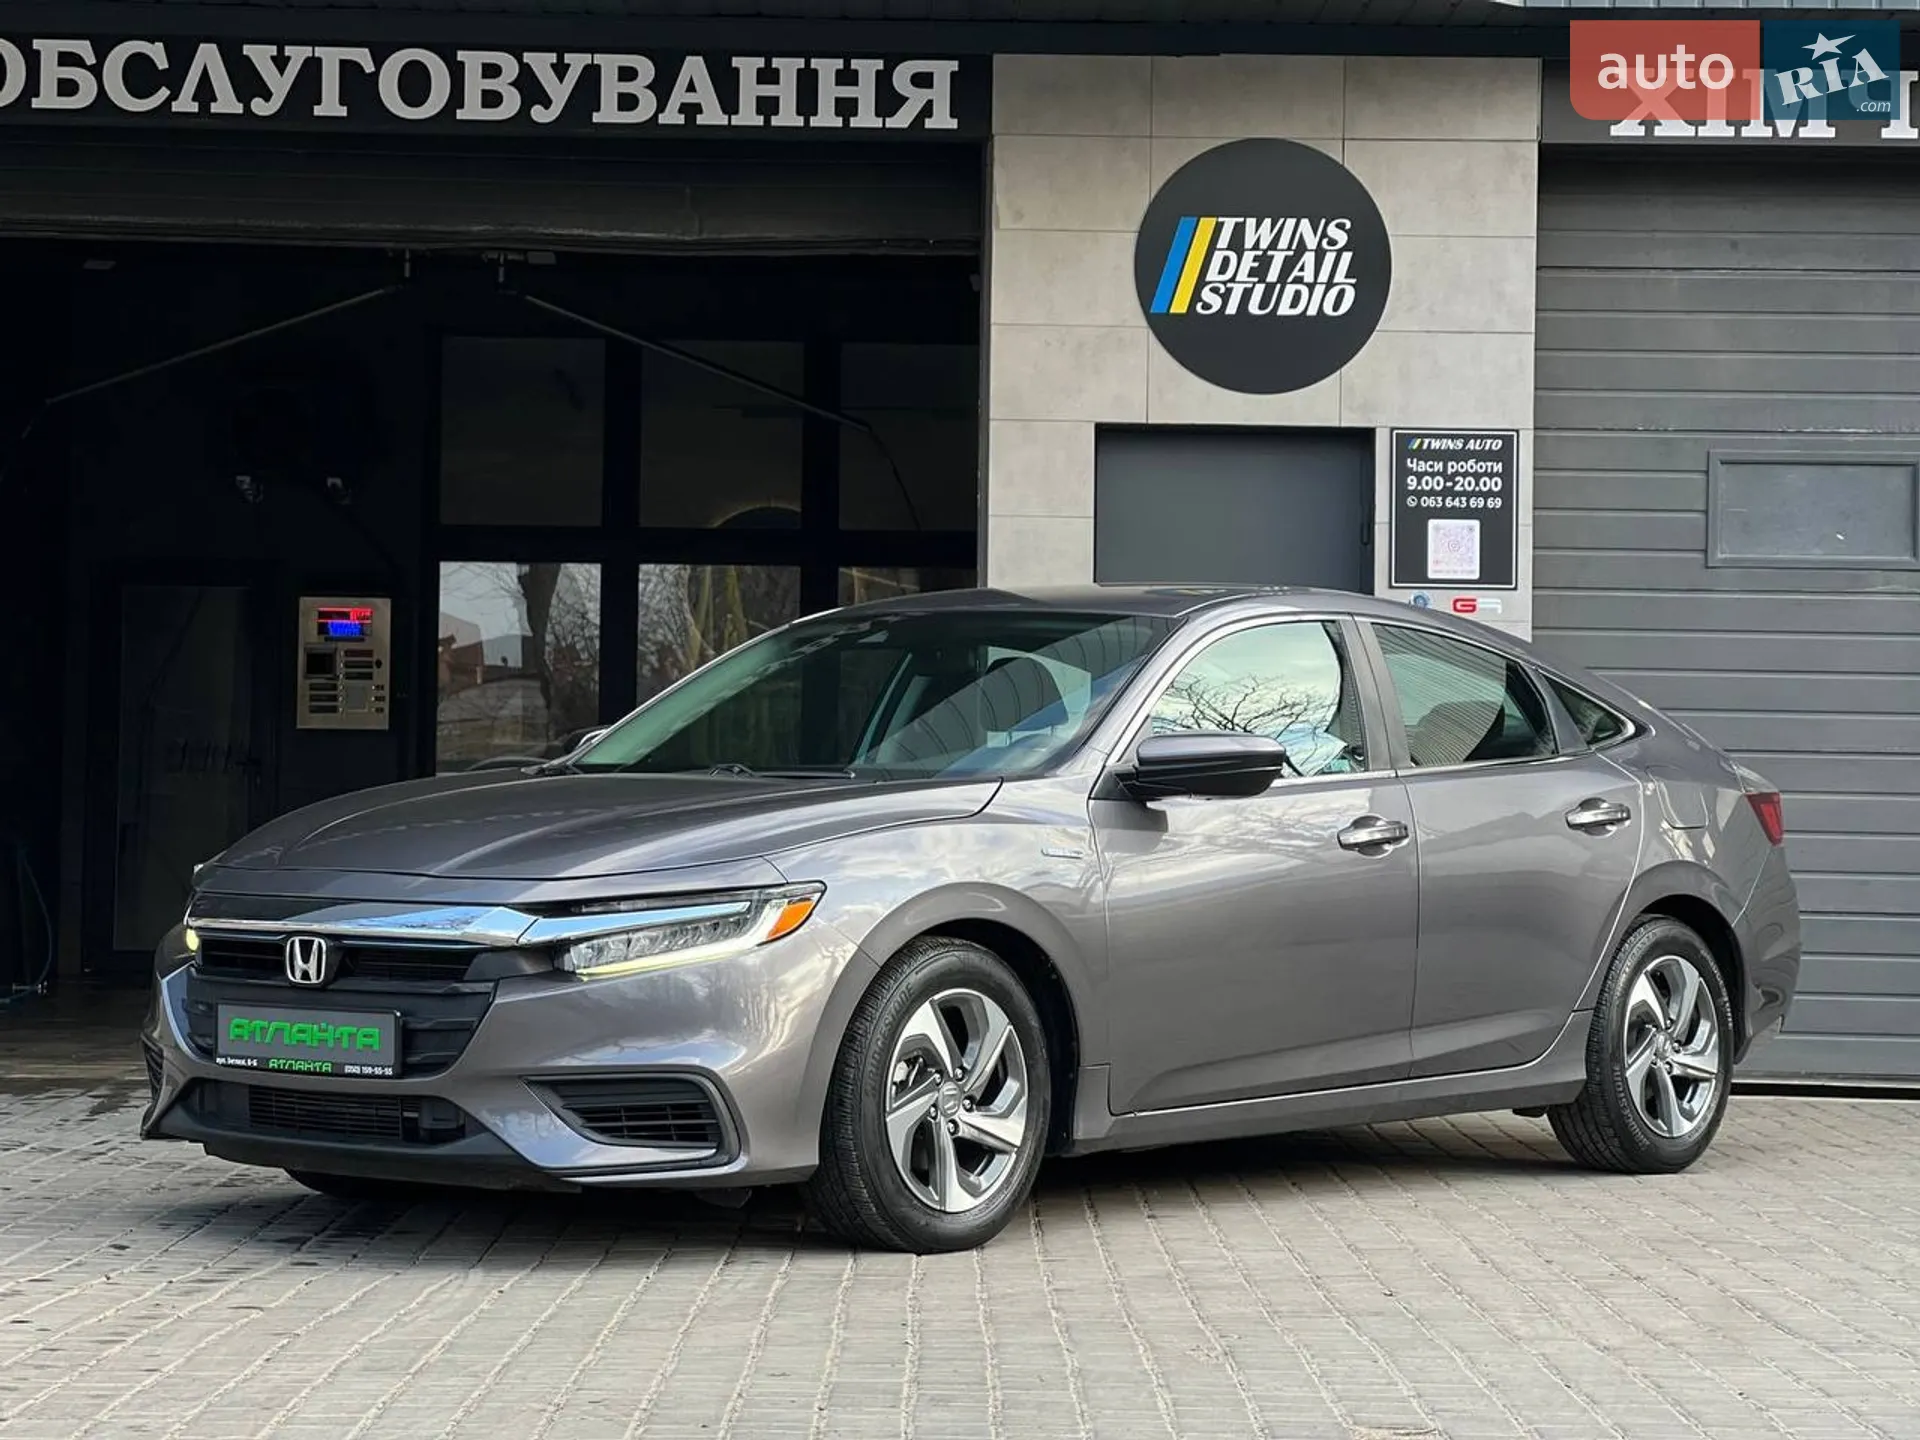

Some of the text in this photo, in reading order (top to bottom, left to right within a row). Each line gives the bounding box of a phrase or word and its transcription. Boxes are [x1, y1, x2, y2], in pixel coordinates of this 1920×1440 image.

[1216, 217, 1352, 250] TWINS
[1205, 251, 1357, 283] DETAIL
[1195, 283, 1356, 316] STUDIO
[1422, 438, 1503, 451] TWINS AUTO
[1406, 457, 1503, 475] Часи роботи
[1406, 475, 1503, 492] 9.00-20.00
[1420, 496, 1502, 509] 063 643 69 69
